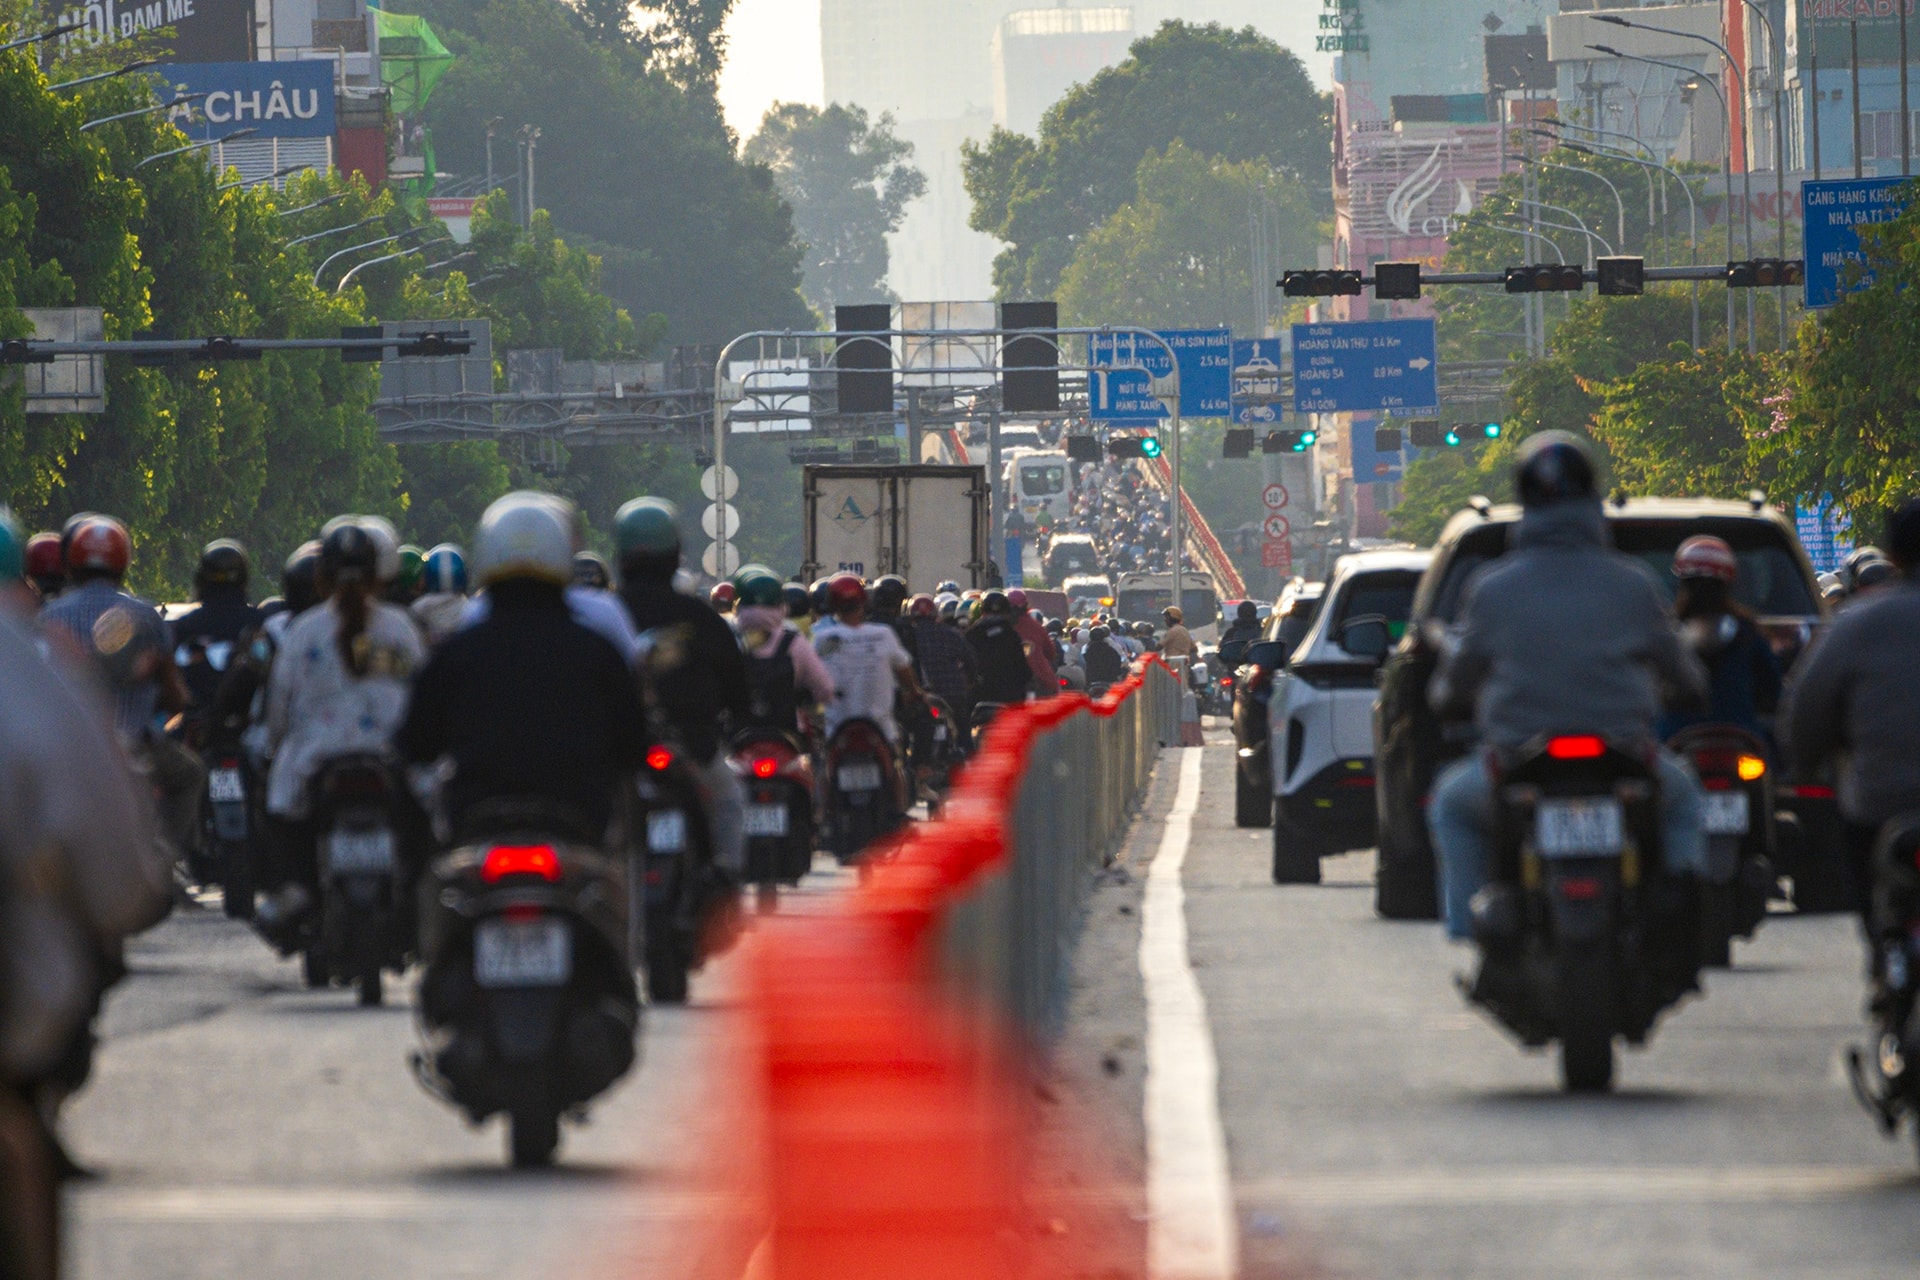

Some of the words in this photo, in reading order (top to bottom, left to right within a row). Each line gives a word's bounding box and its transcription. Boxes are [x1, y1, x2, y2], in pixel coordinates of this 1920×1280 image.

[204, 80, 318, 123] CHÂU
[1807, 187, 1836, 206] CẢNG
[1838, 186, 1866, 204] HÀNG
[1828, 207, 1852, 225] NHÀ
[1855, 210, 1868, 224] GA
[833, 495, 868, 520] A
